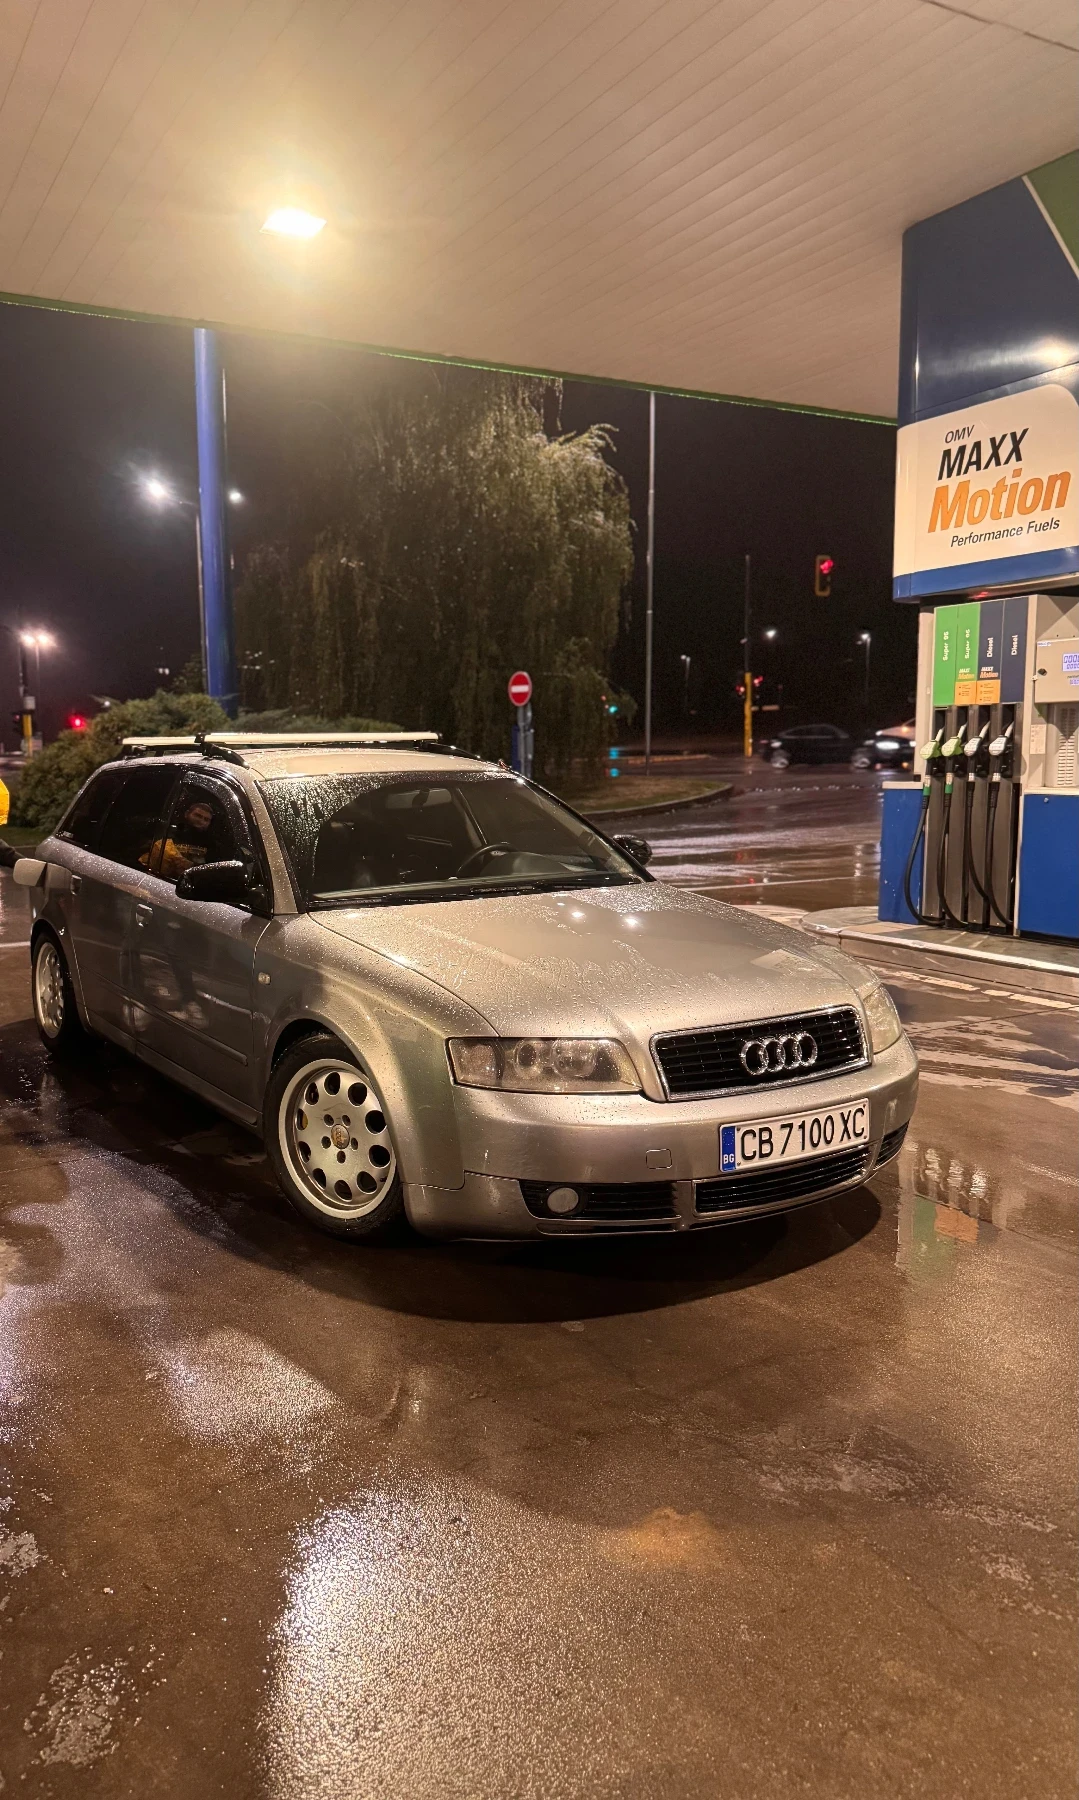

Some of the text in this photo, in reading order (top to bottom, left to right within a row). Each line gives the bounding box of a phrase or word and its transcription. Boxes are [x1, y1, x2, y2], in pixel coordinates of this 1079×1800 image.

[944, 424, 975, 444] OMV
[937, 427, 1029, 481] MAXX
[927, 467, 1072, 533] Motion
[950, 517, 1061, 547] Performance Fuels
[942, 642, 950, 661] Super
[986, 637, 994, 657] Diesel
[740, 1107, 865, 1161] CB 7100 XC
[723, 1153, 735, 1164] BG
